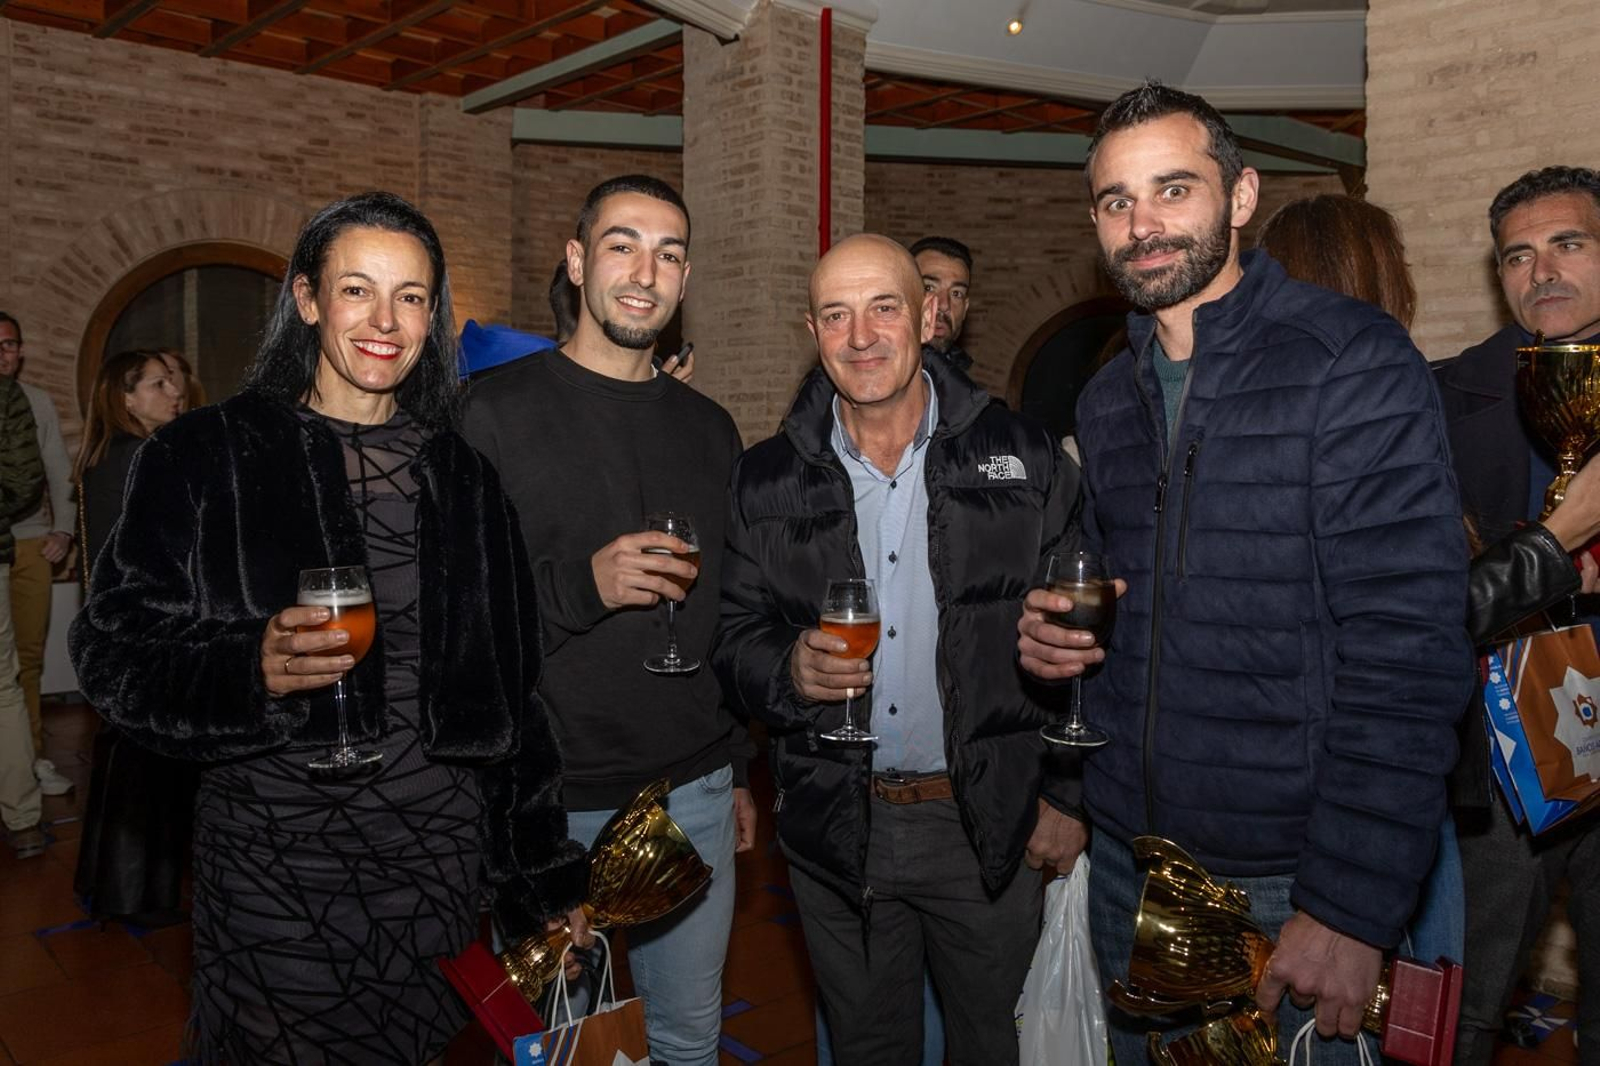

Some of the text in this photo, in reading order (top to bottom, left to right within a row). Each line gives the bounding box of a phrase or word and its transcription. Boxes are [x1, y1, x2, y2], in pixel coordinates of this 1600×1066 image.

[989, 455, 1008, 464] THE
[978, 463, 1010, 472] NORTH
[987, 471, 1011, 480] FACE
